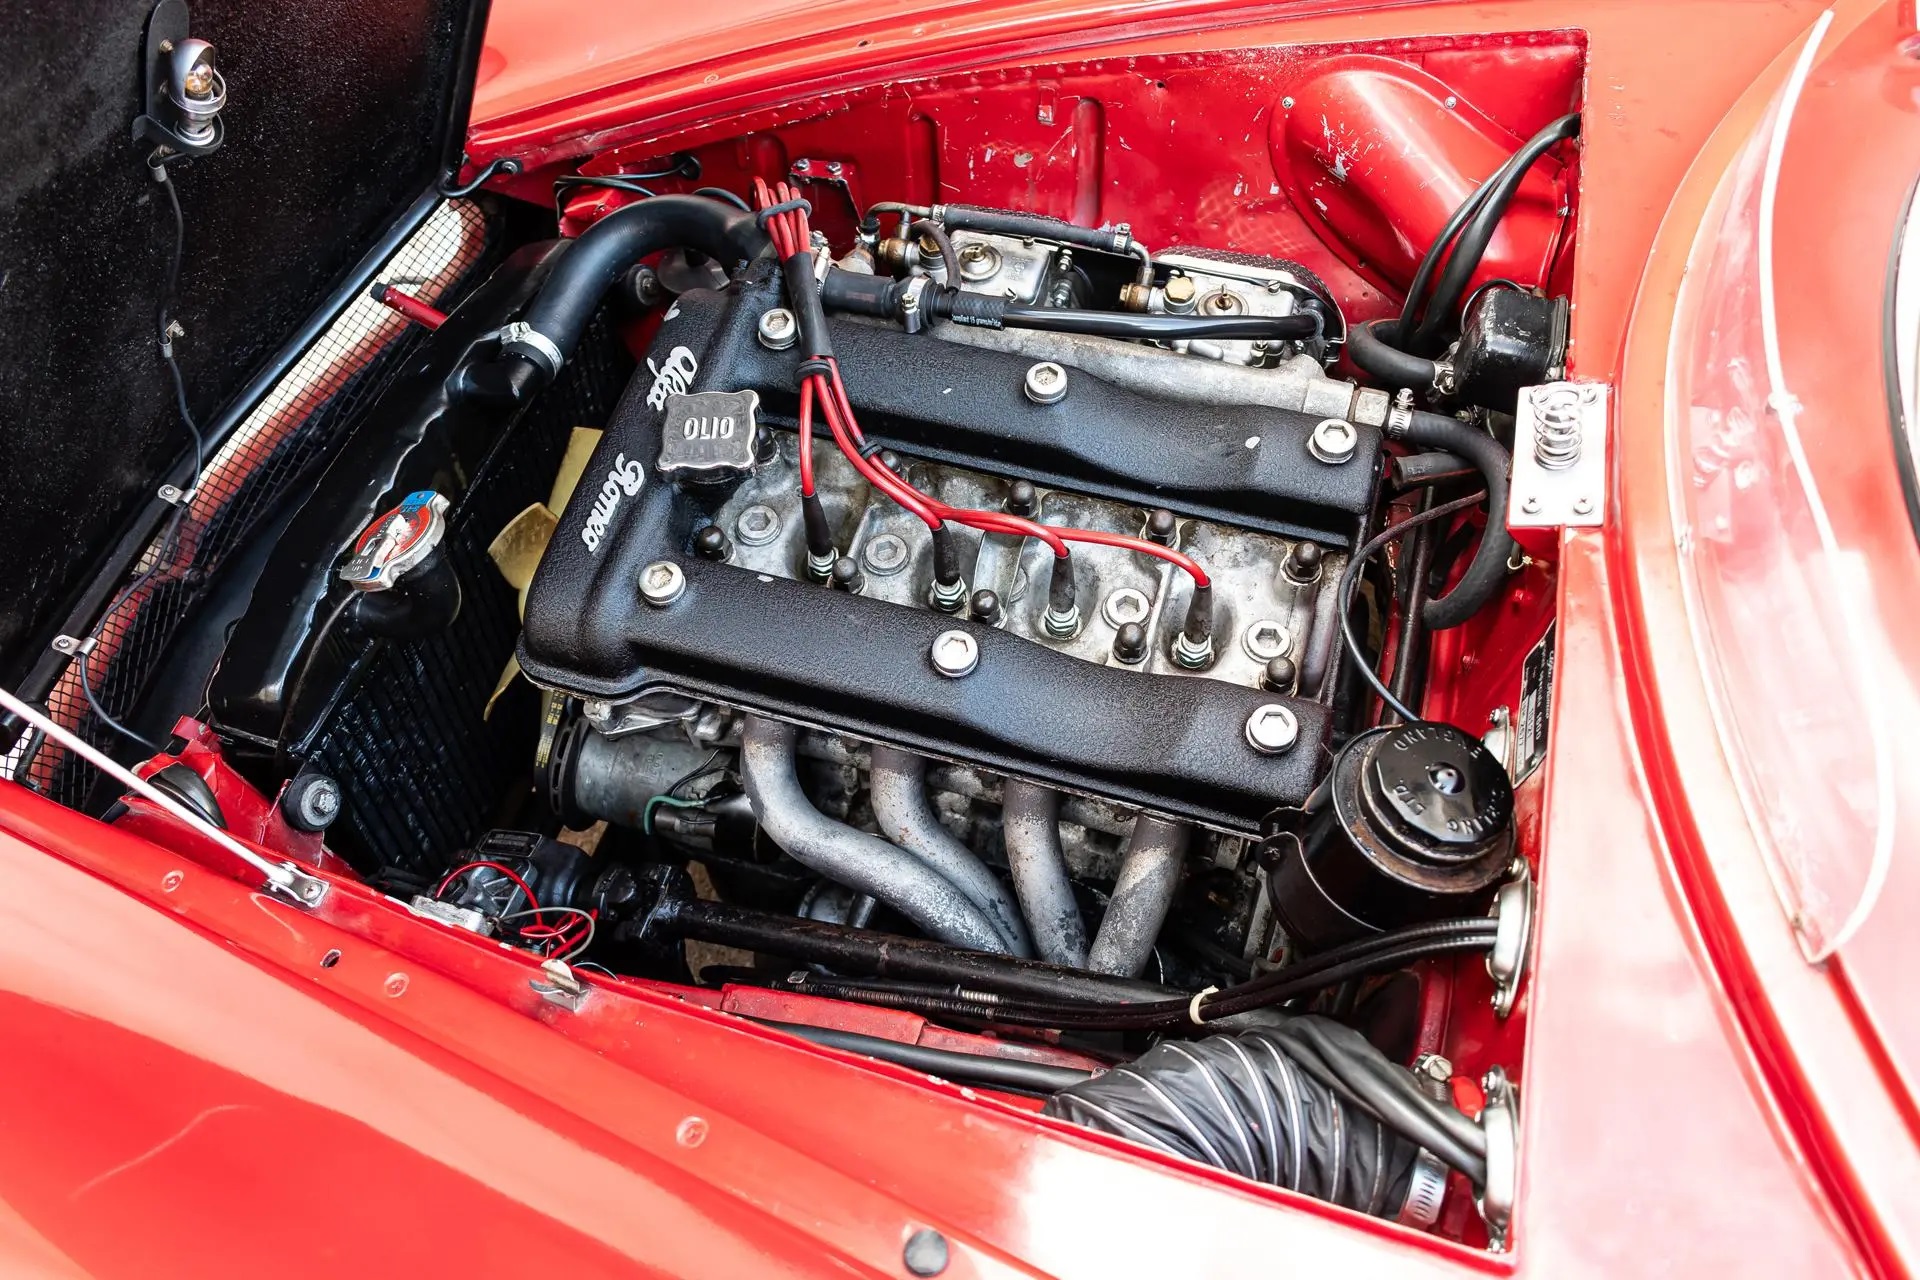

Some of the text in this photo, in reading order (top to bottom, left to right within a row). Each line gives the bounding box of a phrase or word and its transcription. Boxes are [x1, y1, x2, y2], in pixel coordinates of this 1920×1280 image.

[683, 416, 735, 440] OLIO
[582, 345, 698, 552] Alfa Romeo
[1535, 712, 1543, 740] 1600
